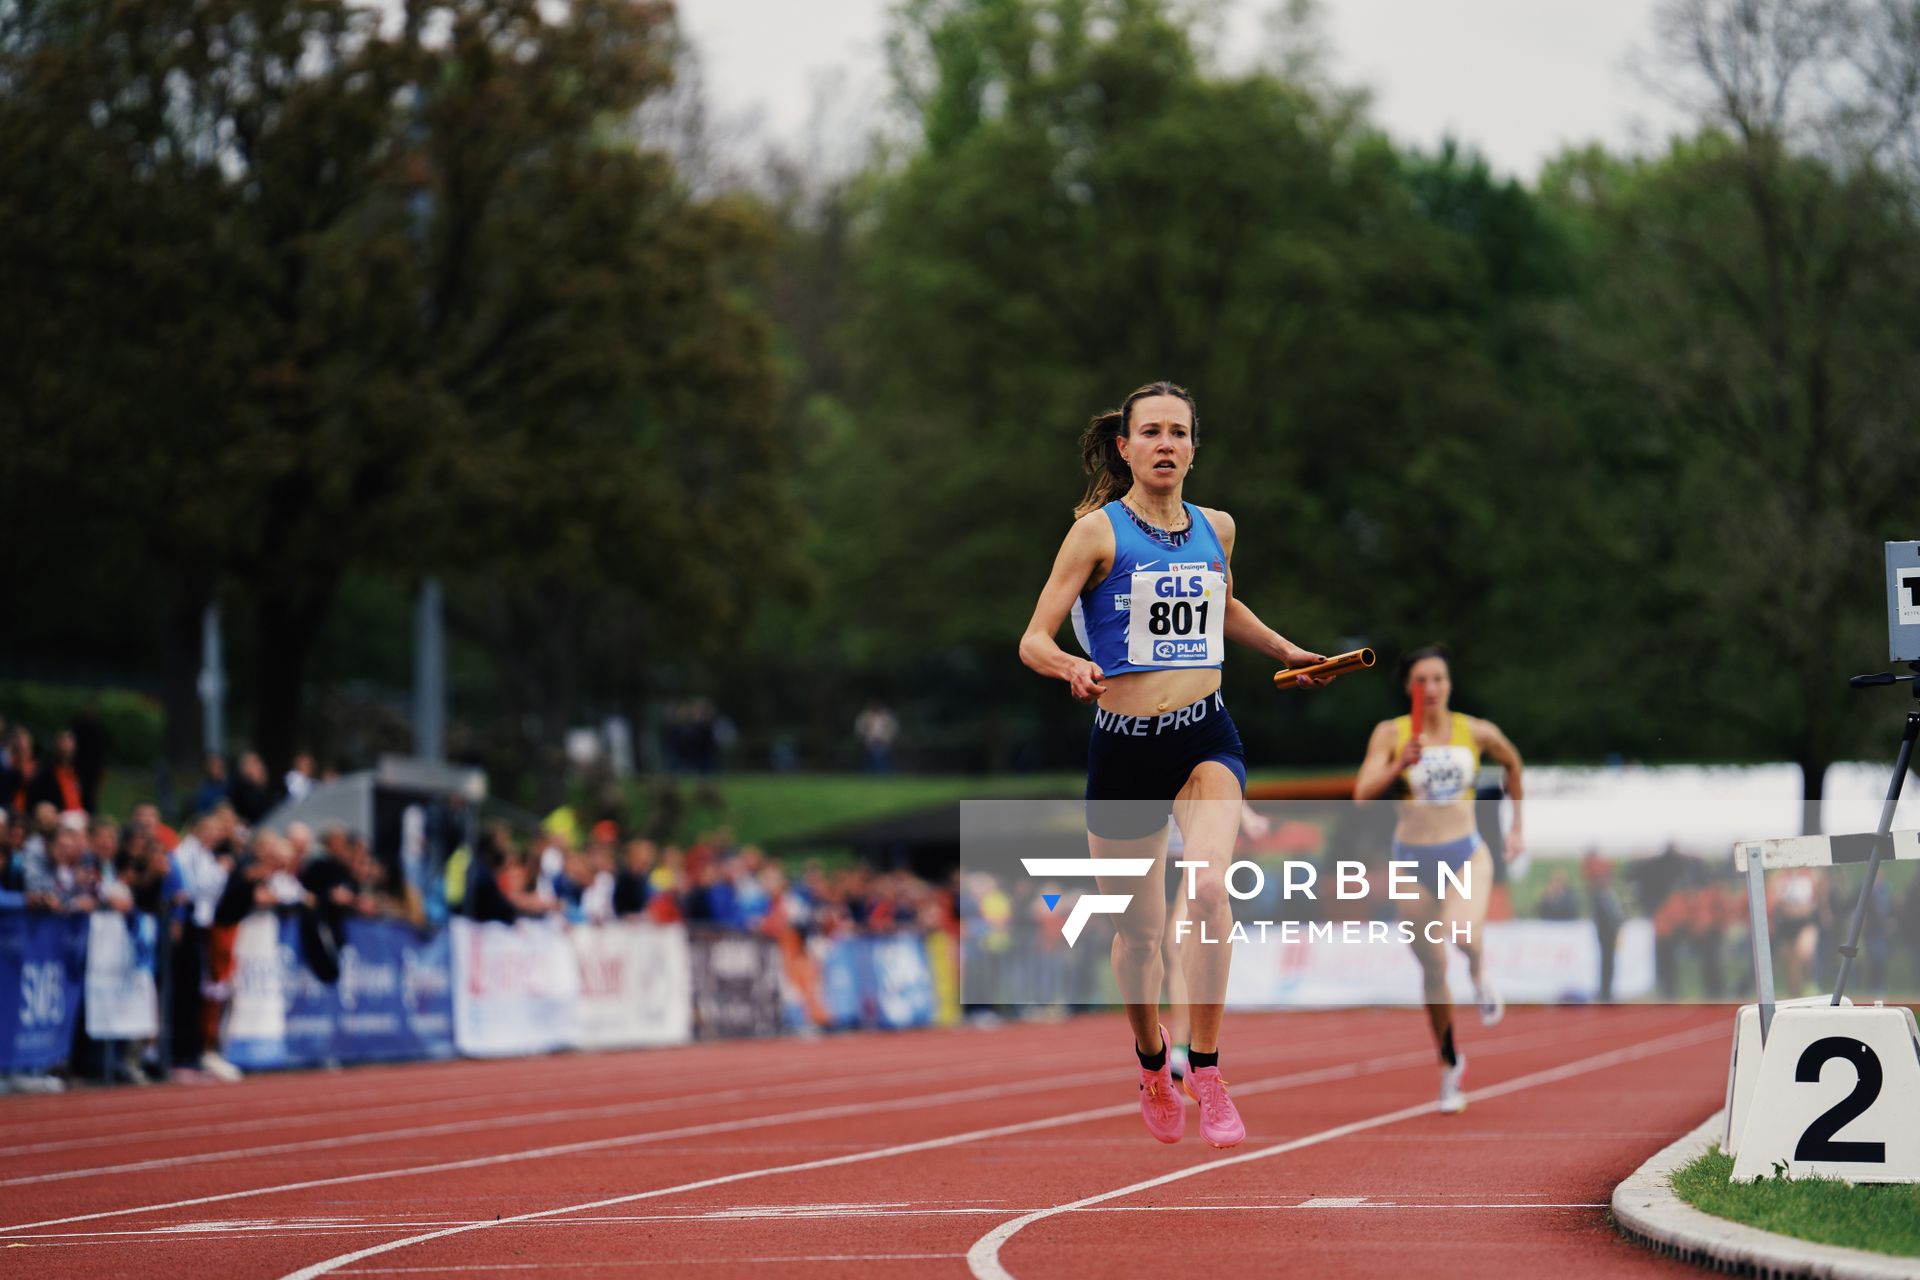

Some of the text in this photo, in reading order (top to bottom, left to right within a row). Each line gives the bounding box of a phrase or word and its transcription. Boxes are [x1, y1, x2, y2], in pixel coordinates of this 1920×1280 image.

[1149, 600, 1209, 635] 801
[1177, 642, 1206, 653] PLAN
[1095, 708, 1152, 736] NIKE
[1156, 699, 1207, 735] PRO
[1794, 1036, 1886, 1163] 2
